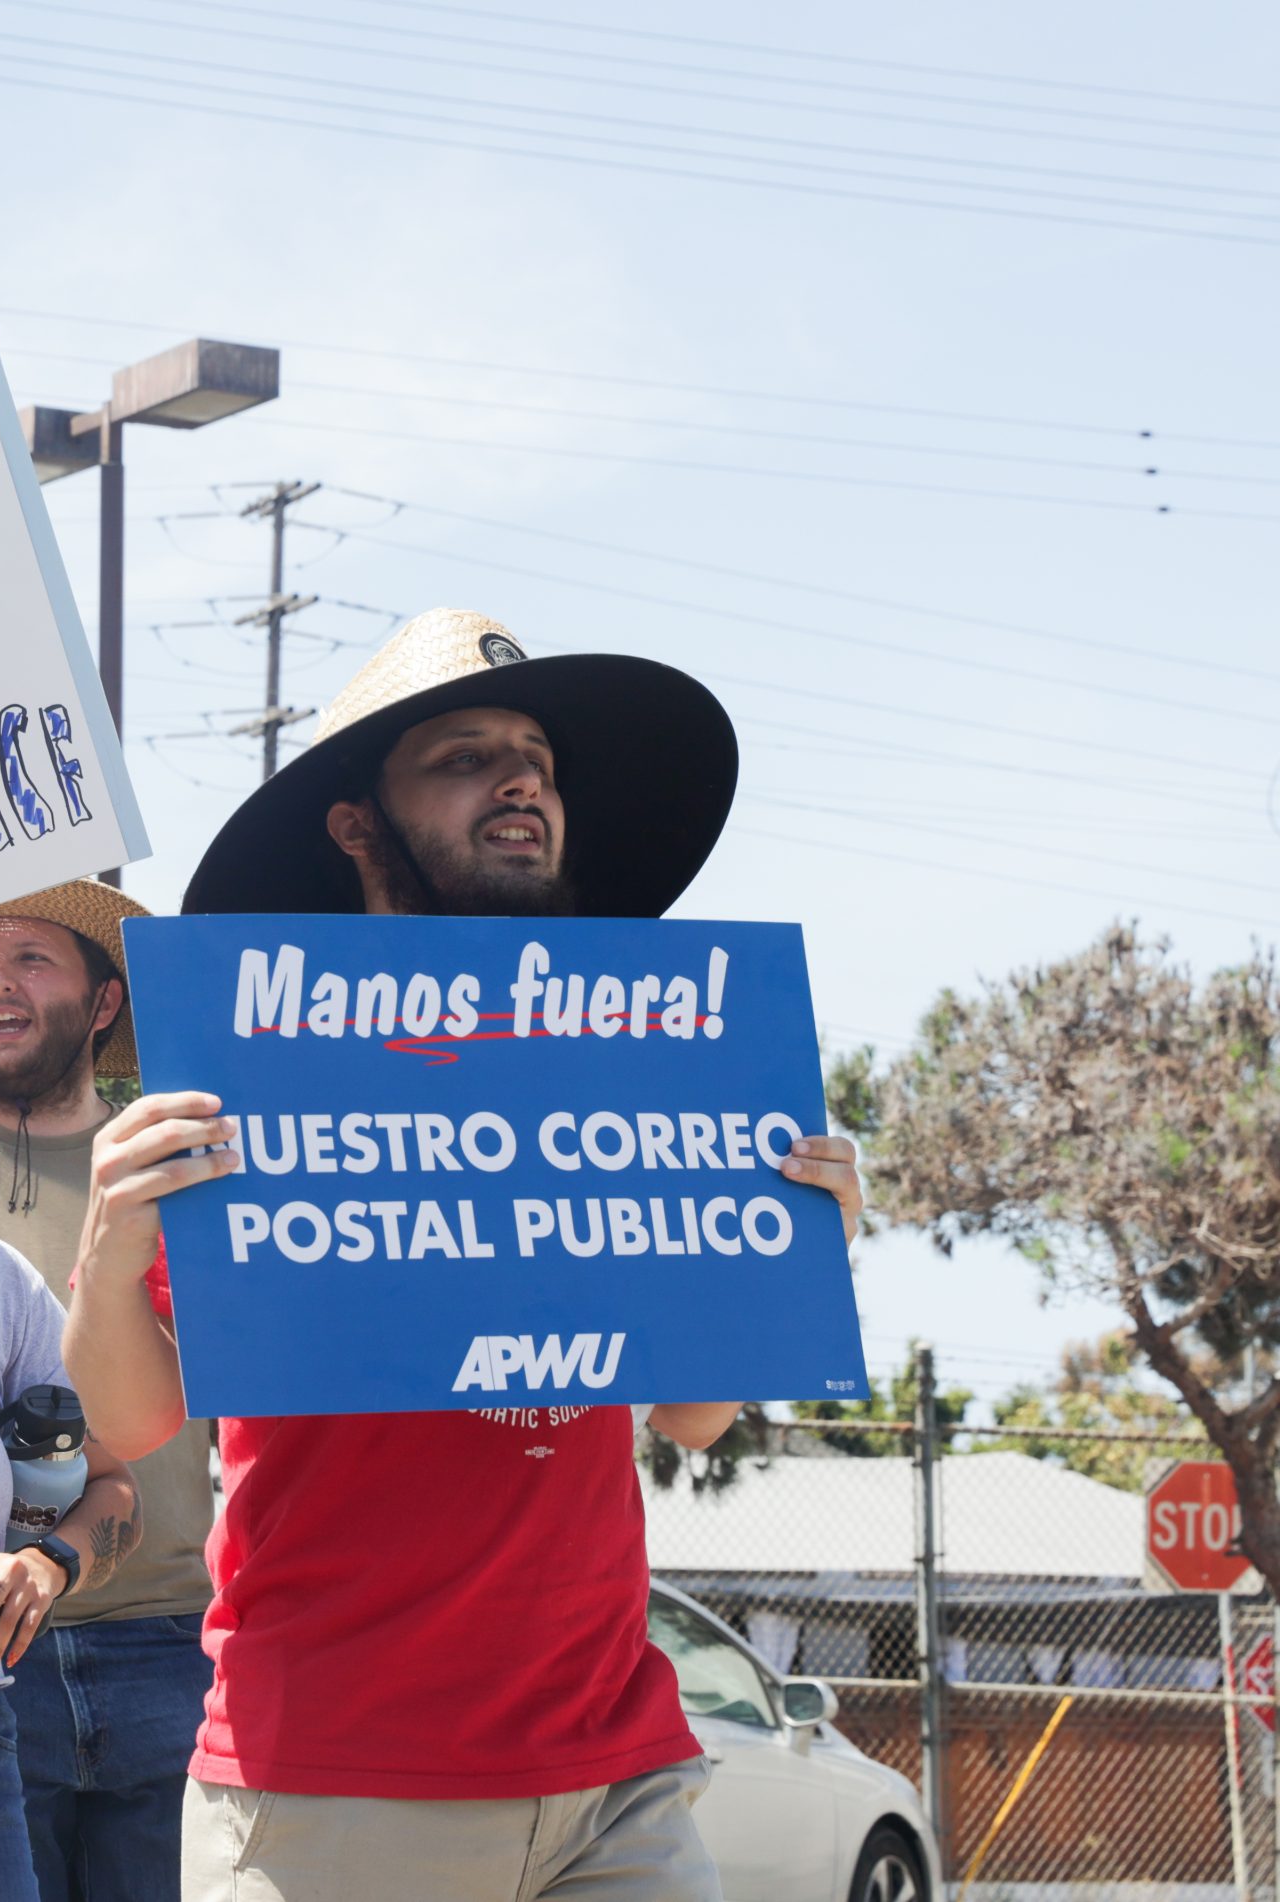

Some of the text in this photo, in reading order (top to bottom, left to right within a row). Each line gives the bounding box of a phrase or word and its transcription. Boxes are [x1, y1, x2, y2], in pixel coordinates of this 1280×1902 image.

[233, 941, 729, 1040] Manos fuera!
[538, 1111, 799, 1172] CORREO
[226, 1195, 793, 1264] POSTAL PUBLICO
[451, 1332, 626, 1392] APWU
